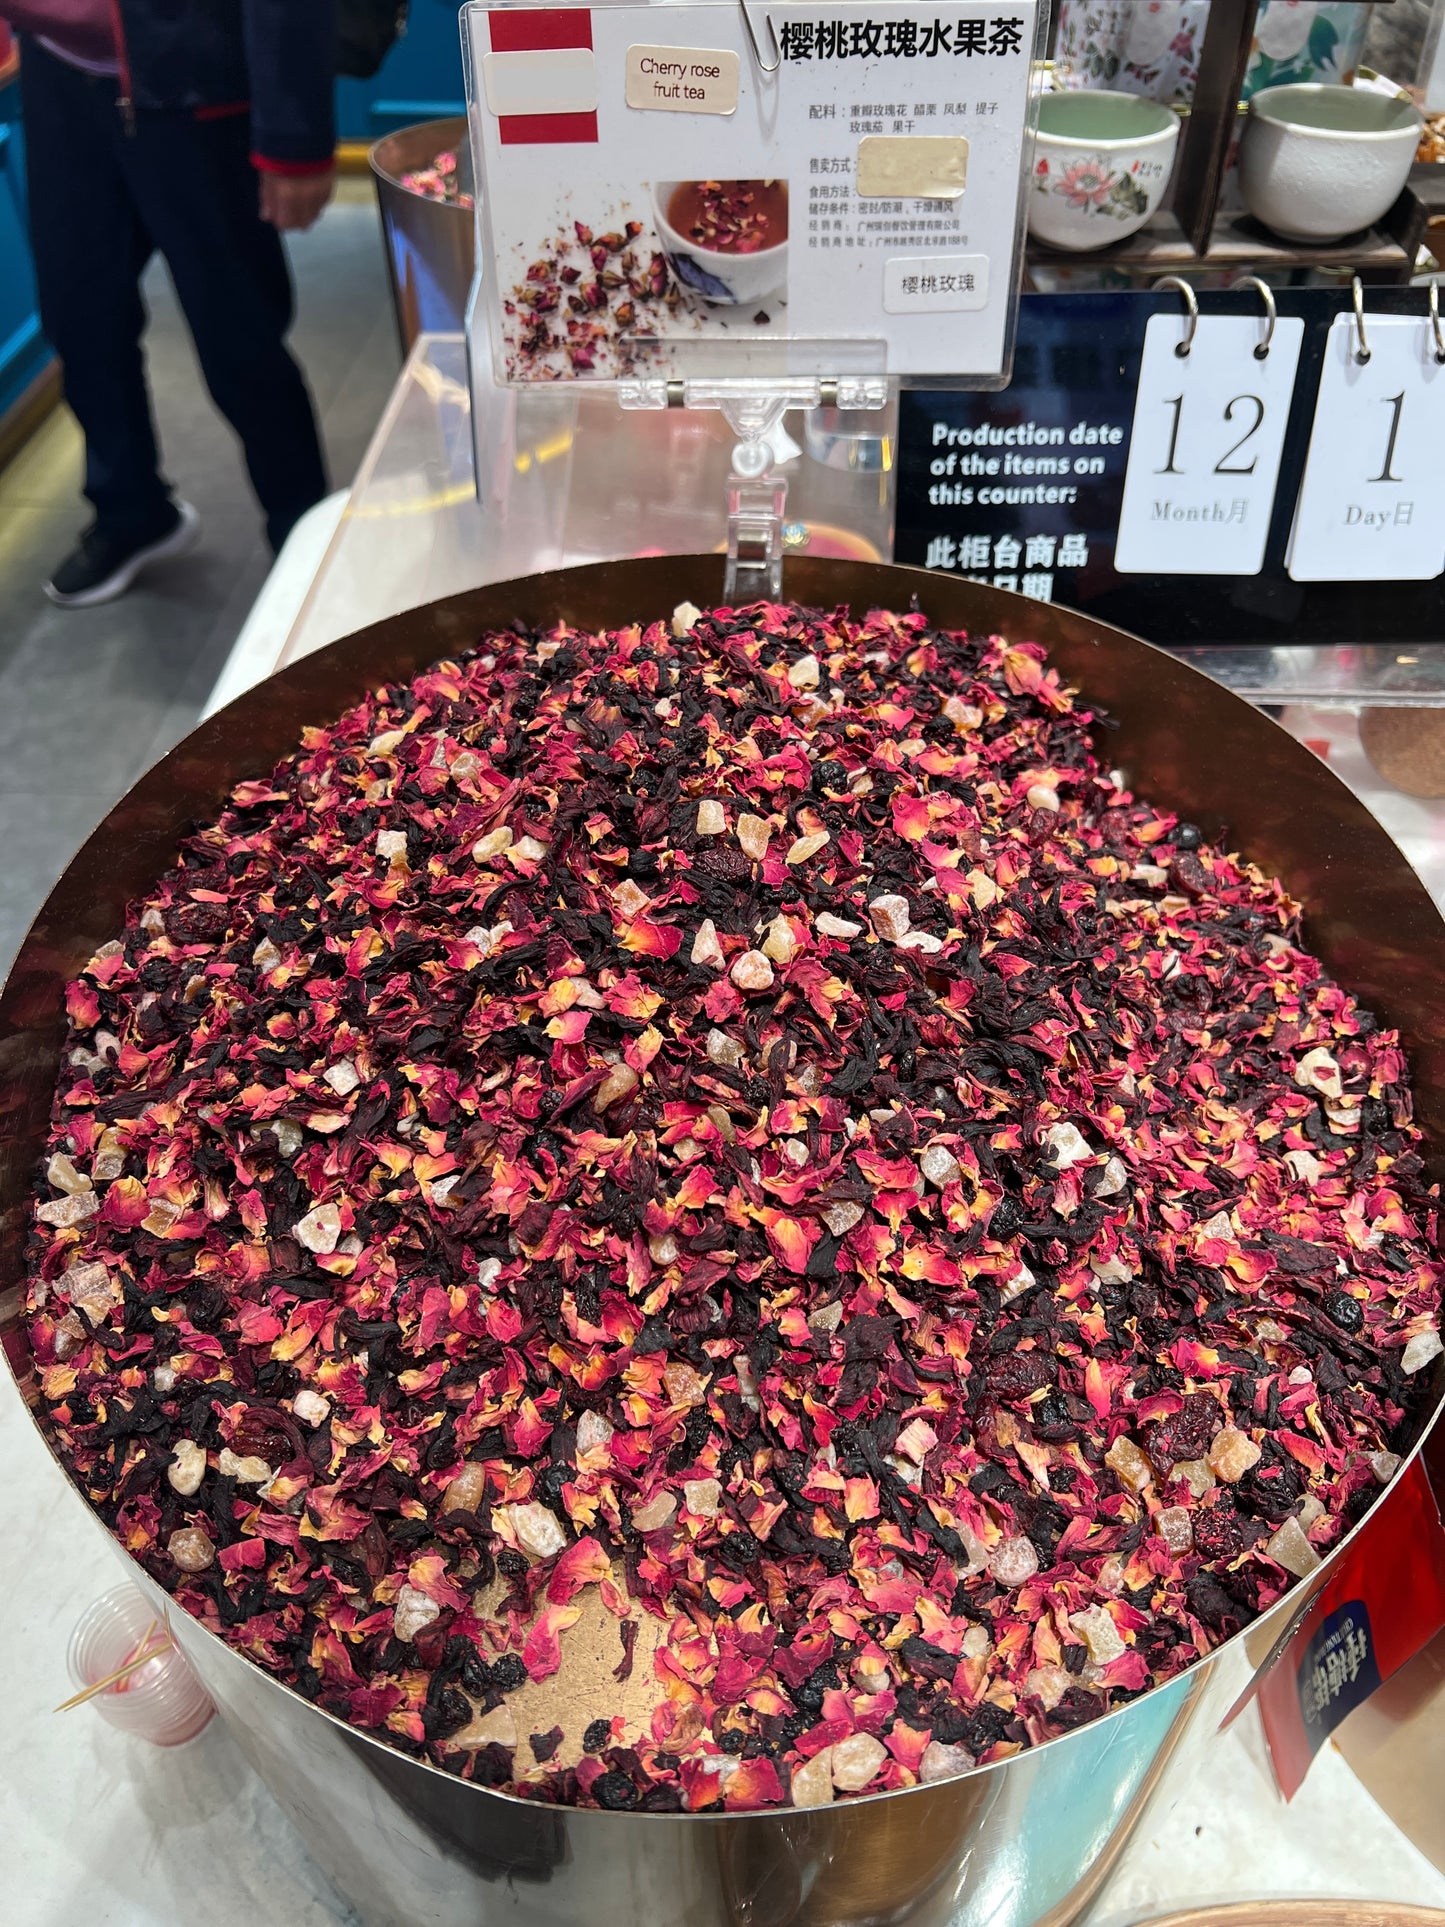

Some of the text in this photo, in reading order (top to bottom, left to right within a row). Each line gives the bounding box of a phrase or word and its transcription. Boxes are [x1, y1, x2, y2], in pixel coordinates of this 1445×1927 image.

[780, 17, 1024, 60] 樱桃玫瑰水果茶
[640, 58, 720, 80] Cherry rose
[653, 82, 705, 100] fruit tea
[975, 102, 998, 116] 提子
[892, 120, 915, 133] 果干
[902, 273, 976, 295] 樱桃玫瑰
[932, 421, 1124, 446] Production date
[1367, 390, 1405, 482] 1
[930, 451, 1105, 476] of the items on
[928, 481, 1078, 505] this counter:
[925, 533, 1090, 569] 此柜台商品
